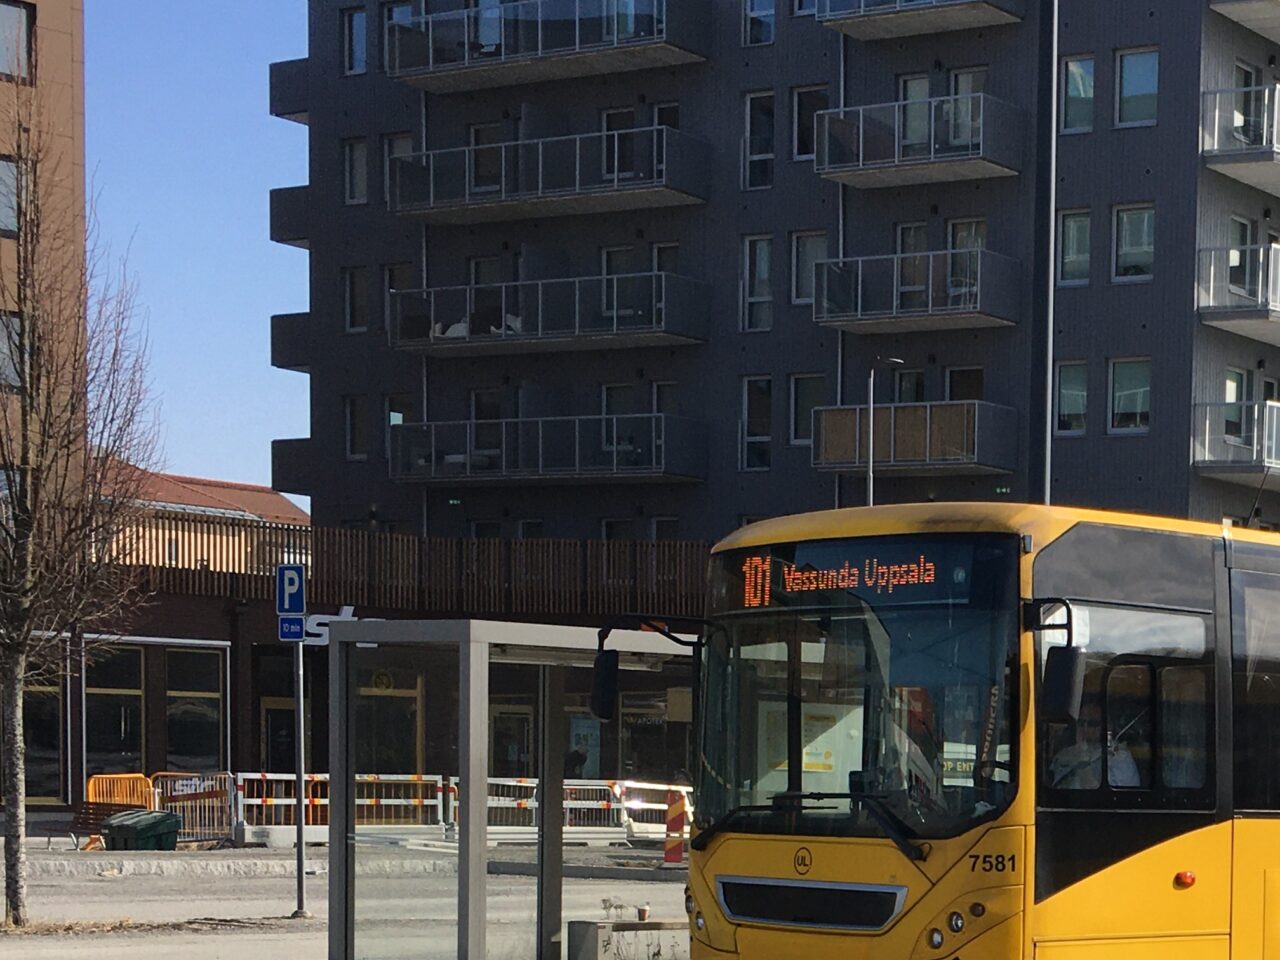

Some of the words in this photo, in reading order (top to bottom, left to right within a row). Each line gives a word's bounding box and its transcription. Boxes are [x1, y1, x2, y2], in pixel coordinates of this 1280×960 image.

[284, 570, 299, 609] P
[742, 556, 771, 607] 101
[864, 555, 936, 593] Uppsala
[797, 855, 809, 868] UL
[968, 854, 1017, 873] 7581
